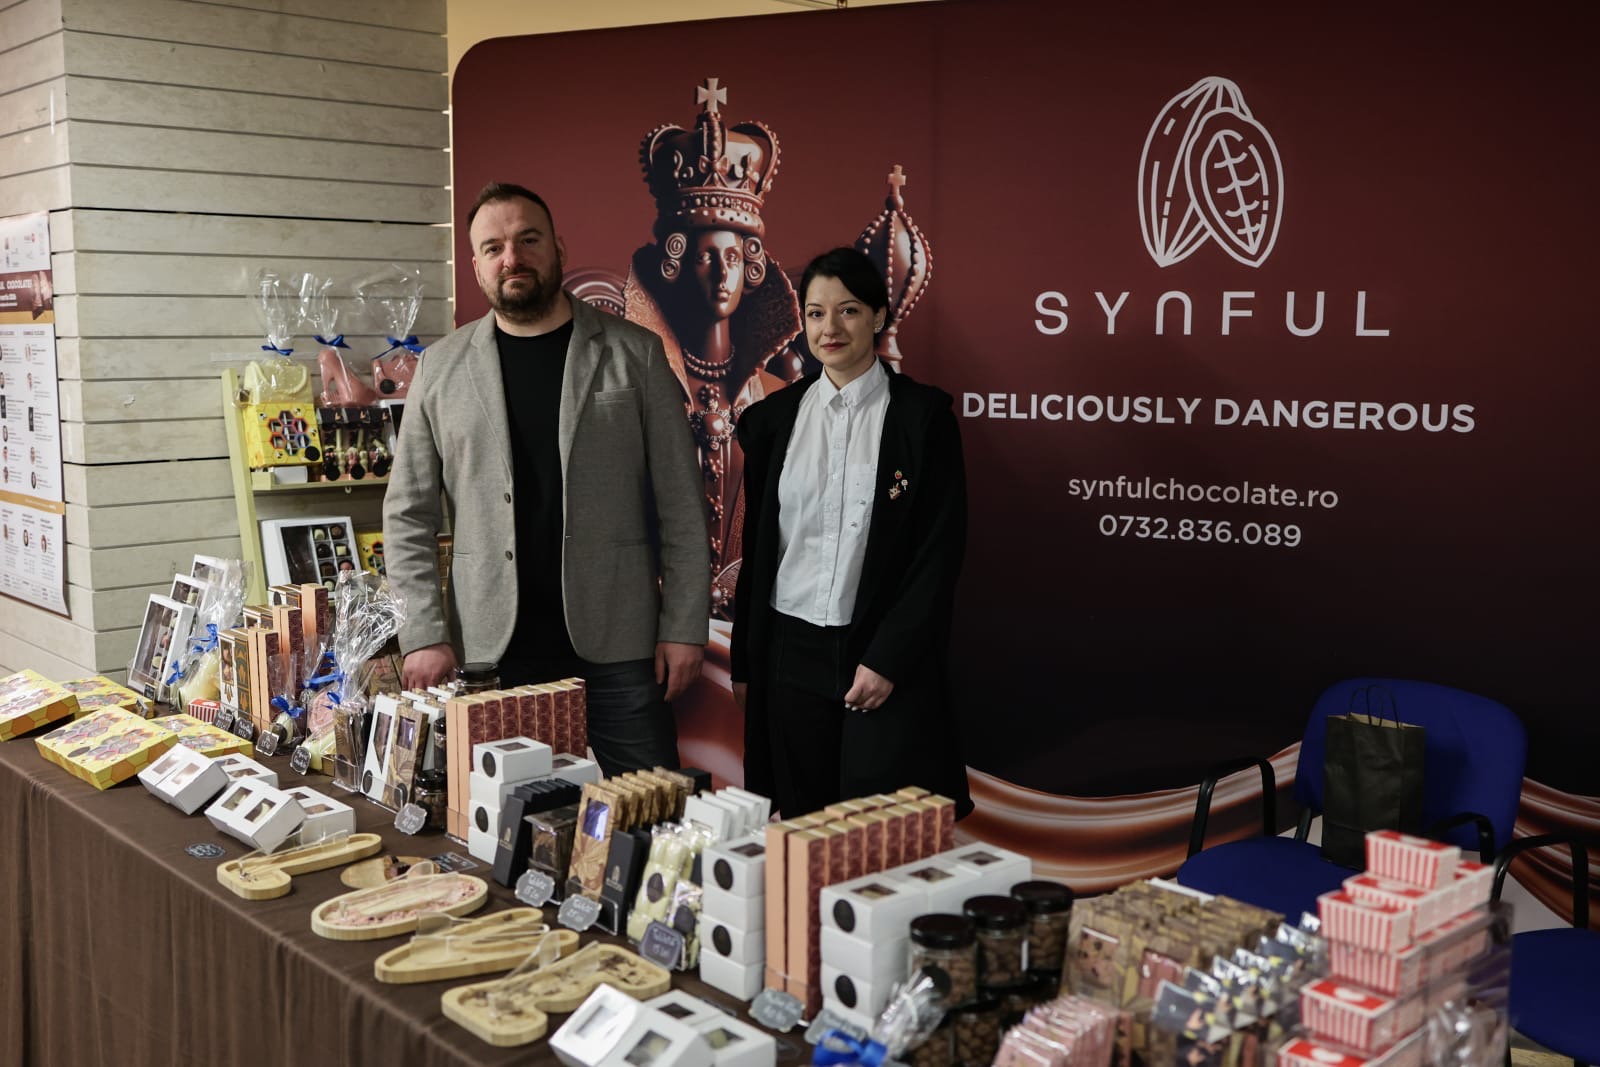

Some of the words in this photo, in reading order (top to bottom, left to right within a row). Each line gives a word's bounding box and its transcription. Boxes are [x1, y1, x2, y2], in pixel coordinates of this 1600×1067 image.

[1034, 290, 1390, 337] SYNFUL
[962, 392, 1202, 425] DELICIOUSLY
[1214, 398, 1475, 433] DANGEROUS
[1068, 475, 1339, 509] synfulchocolate.ro
[1099, 514, 1302, 547] 0732.836.089
